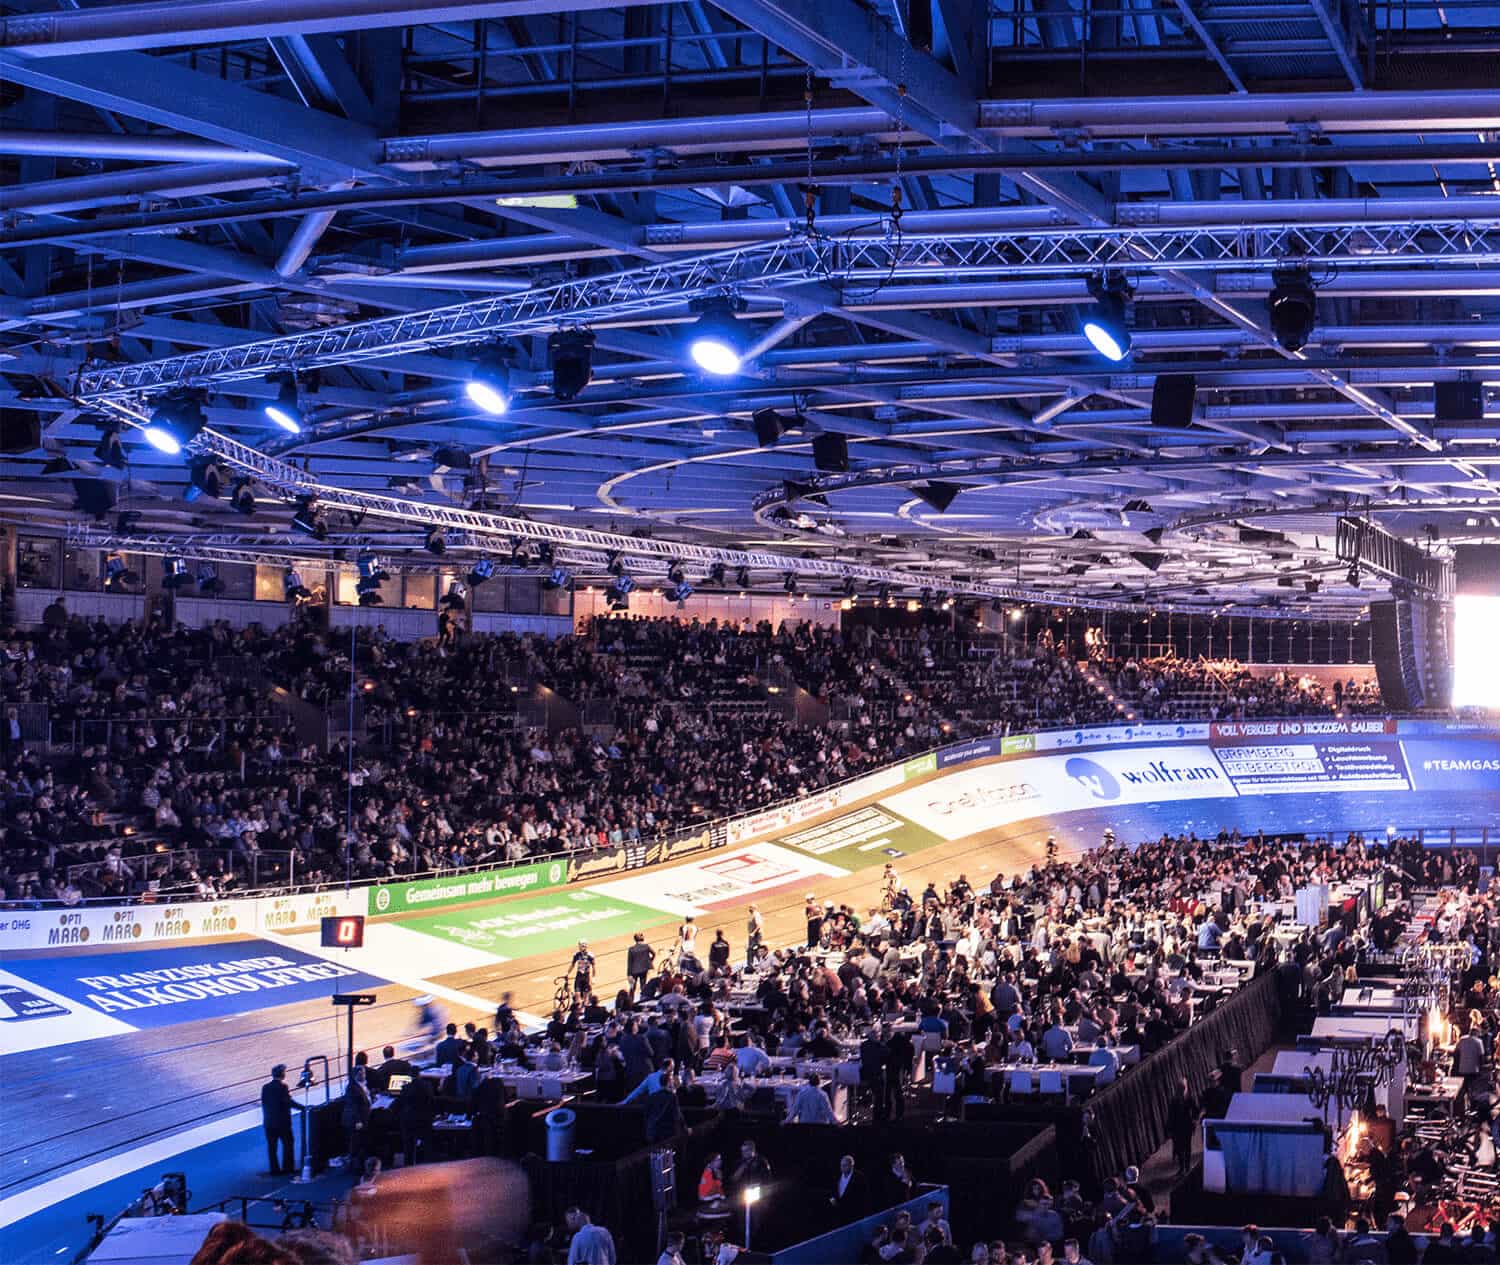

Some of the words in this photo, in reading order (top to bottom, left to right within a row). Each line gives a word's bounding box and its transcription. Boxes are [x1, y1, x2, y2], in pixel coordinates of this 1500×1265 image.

[1217, 725, 1239, 737] VOLL
[1280, 722, 1301, 735] UND
[1351, 721, 1385, 733] SAUBER
[1218, 747, 1295, 760] GRAMBERG
[1122, 760, 1220, 785] wolfram
[406, 883, 467, 904] Gemeinsam
[467, 877, 494, 895] mehr
[494, 871, 539, 890] bewegen
[11, 919, 31, 930] OHG
[76, 955, 297, 991] FRANZISKANER
[86, 961, 359, 1014] ALKOHOLFREI
